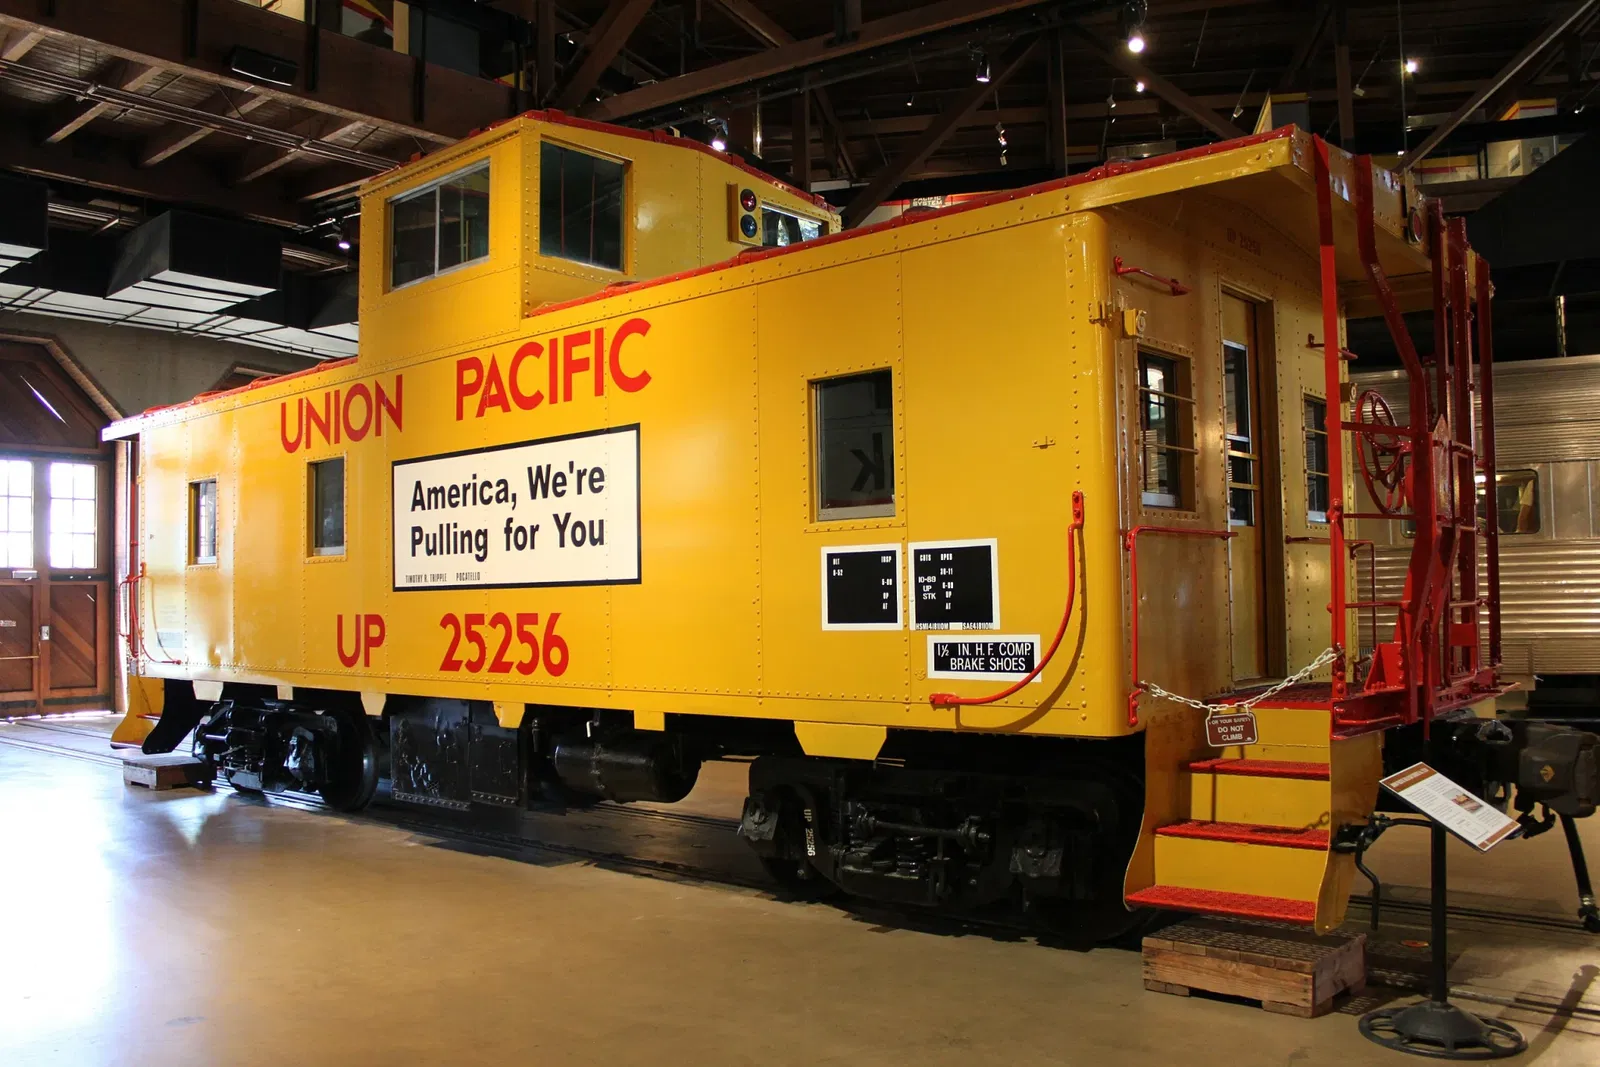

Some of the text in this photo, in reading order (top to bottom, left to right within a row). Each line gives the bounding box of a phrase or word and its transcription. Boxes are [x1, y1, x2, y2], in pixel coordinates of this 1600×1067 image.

[280, 317, 652, 454] UNION PACIFIC
[411, 460, 606, 512] America, We're
[411, 512, 606, 563] Pulling for You
[405, 574, 423, 584] TIMOTHY
[456, 571, 481, 582] POCATELLO
[338, 611, 570, 677] UP 25256
[958, 643, 972, 656] IN.
[975, 643, 985, 656] H.
[950, 657, 1026, 671] BRAKE SHOES
[1230, 724, 1244, 732] NOT
[1221, 733, 1243, 741] CLIMB
[803, 808, 812, 822] UP
